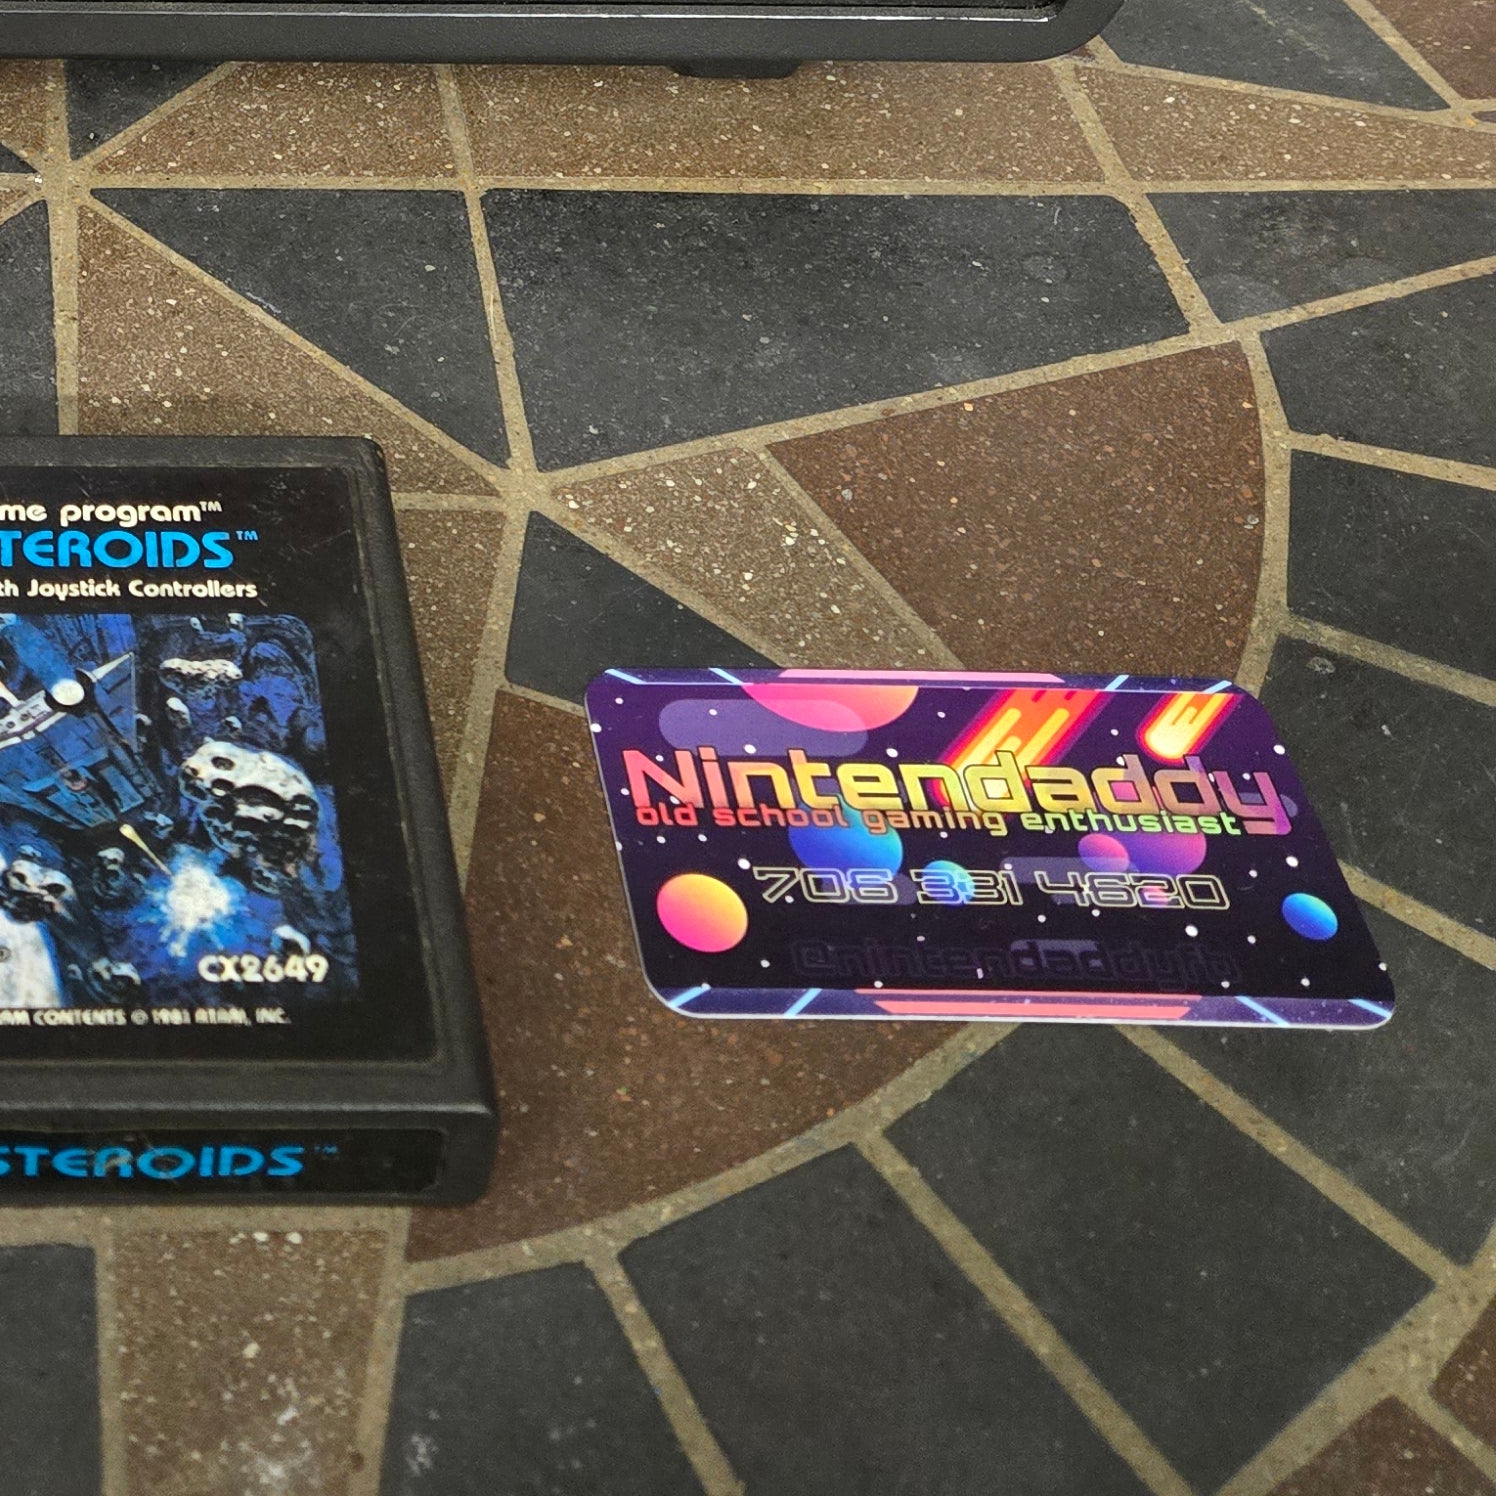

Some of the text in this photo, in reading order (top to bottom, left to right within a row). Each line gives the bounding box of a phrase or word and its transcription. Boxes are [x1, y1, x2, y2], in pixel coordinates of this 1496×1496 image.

[27, 579, 121, 602] Joystick
[128, 579, 258, 599] Controllers
[621, 746, 1292, 835] Nintendaddy
[636, 803, 1241, 836] old school gaming enthusiast
[753, 866, 1230, 911] 706 331 4620
[198, 953, 330, 983] CX2649
[33, 1009, 127, 1026] CONTENTS
